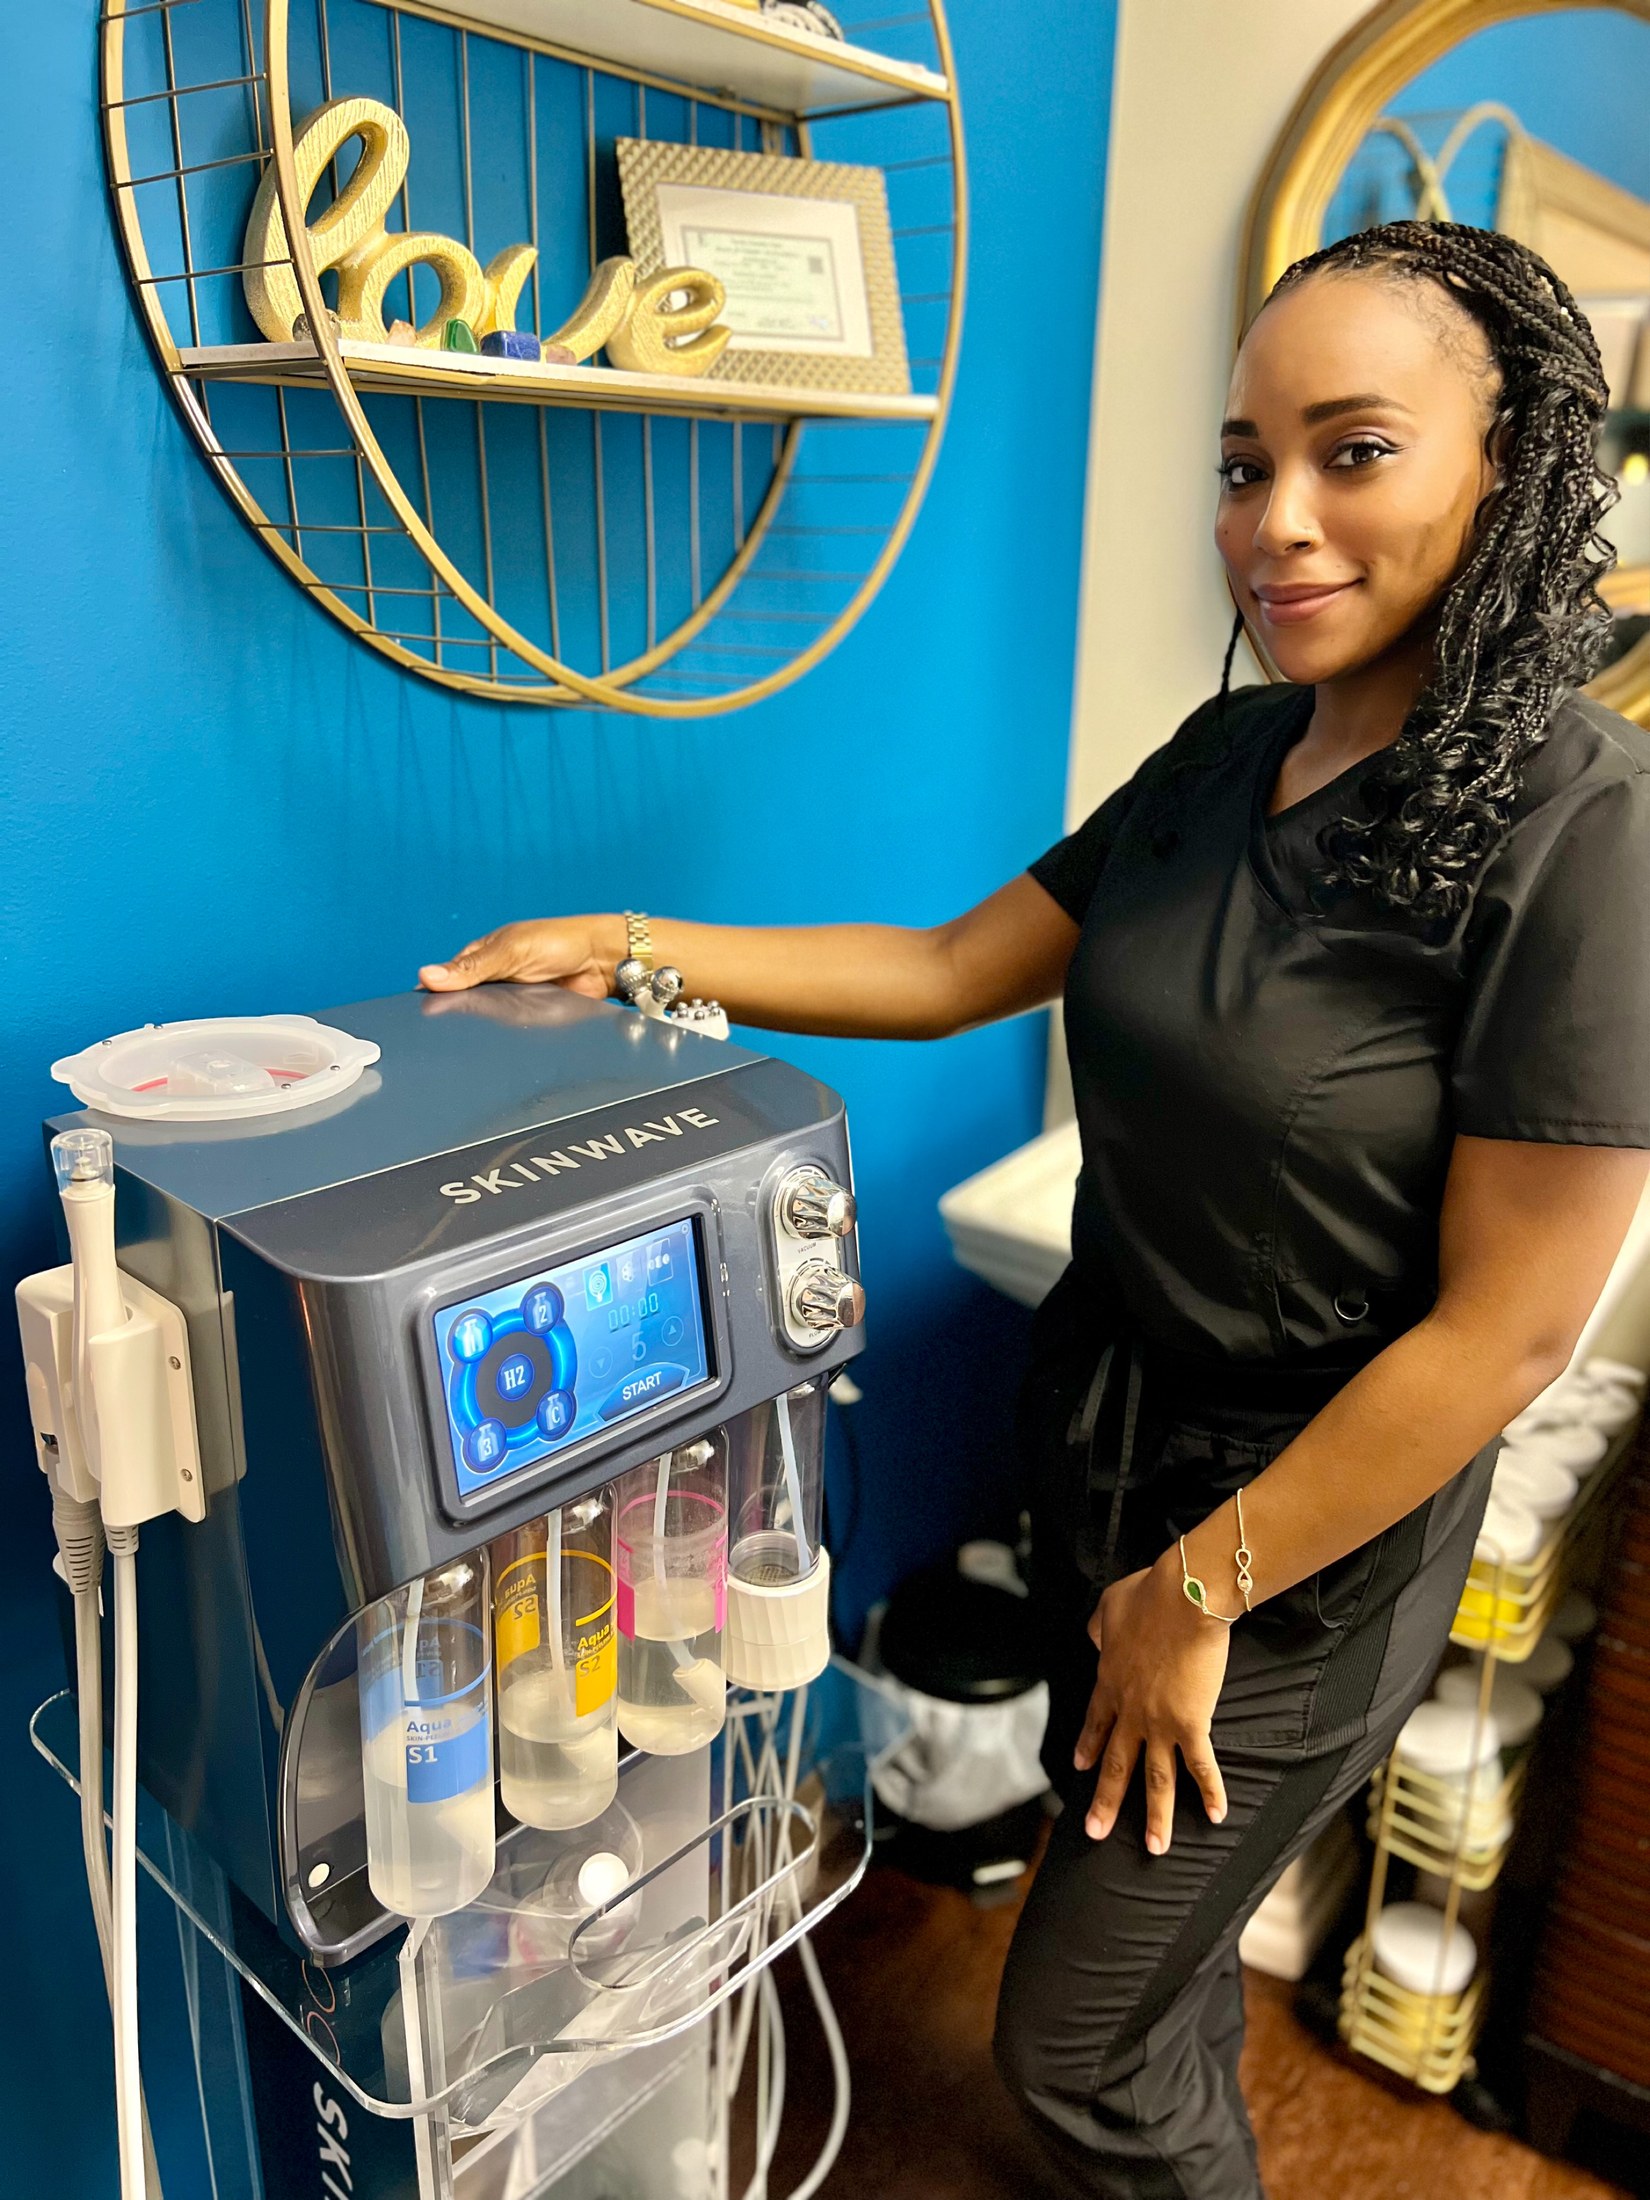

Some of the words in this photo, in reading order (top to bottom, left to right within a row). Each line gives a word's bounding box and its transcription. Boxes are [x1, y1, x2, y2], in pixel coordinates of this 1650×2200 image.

[244, 97, 732, 376] love
[439, 1107, 720, 1205] SKINWAVE
[538, 1306, 548, 1323] 2
[608, 1292, 659, 1333] 00:00
[631, 1331, 647, 1362] 5
[503, 1366, 526, 1391] H2
[621, 1371, 662, 1401] START
[551, 1405, 560, 1424] C
[483, 1437, 491, 1456] 3
[577, 1624, 610, 1651] Aqua
[579, 1655, 601, 1678] S2
[406, 1719, 452, 1735] Aqua
[408, 1745, 438, 1764] S1
[313, 2082, 352, 2200] SKI
